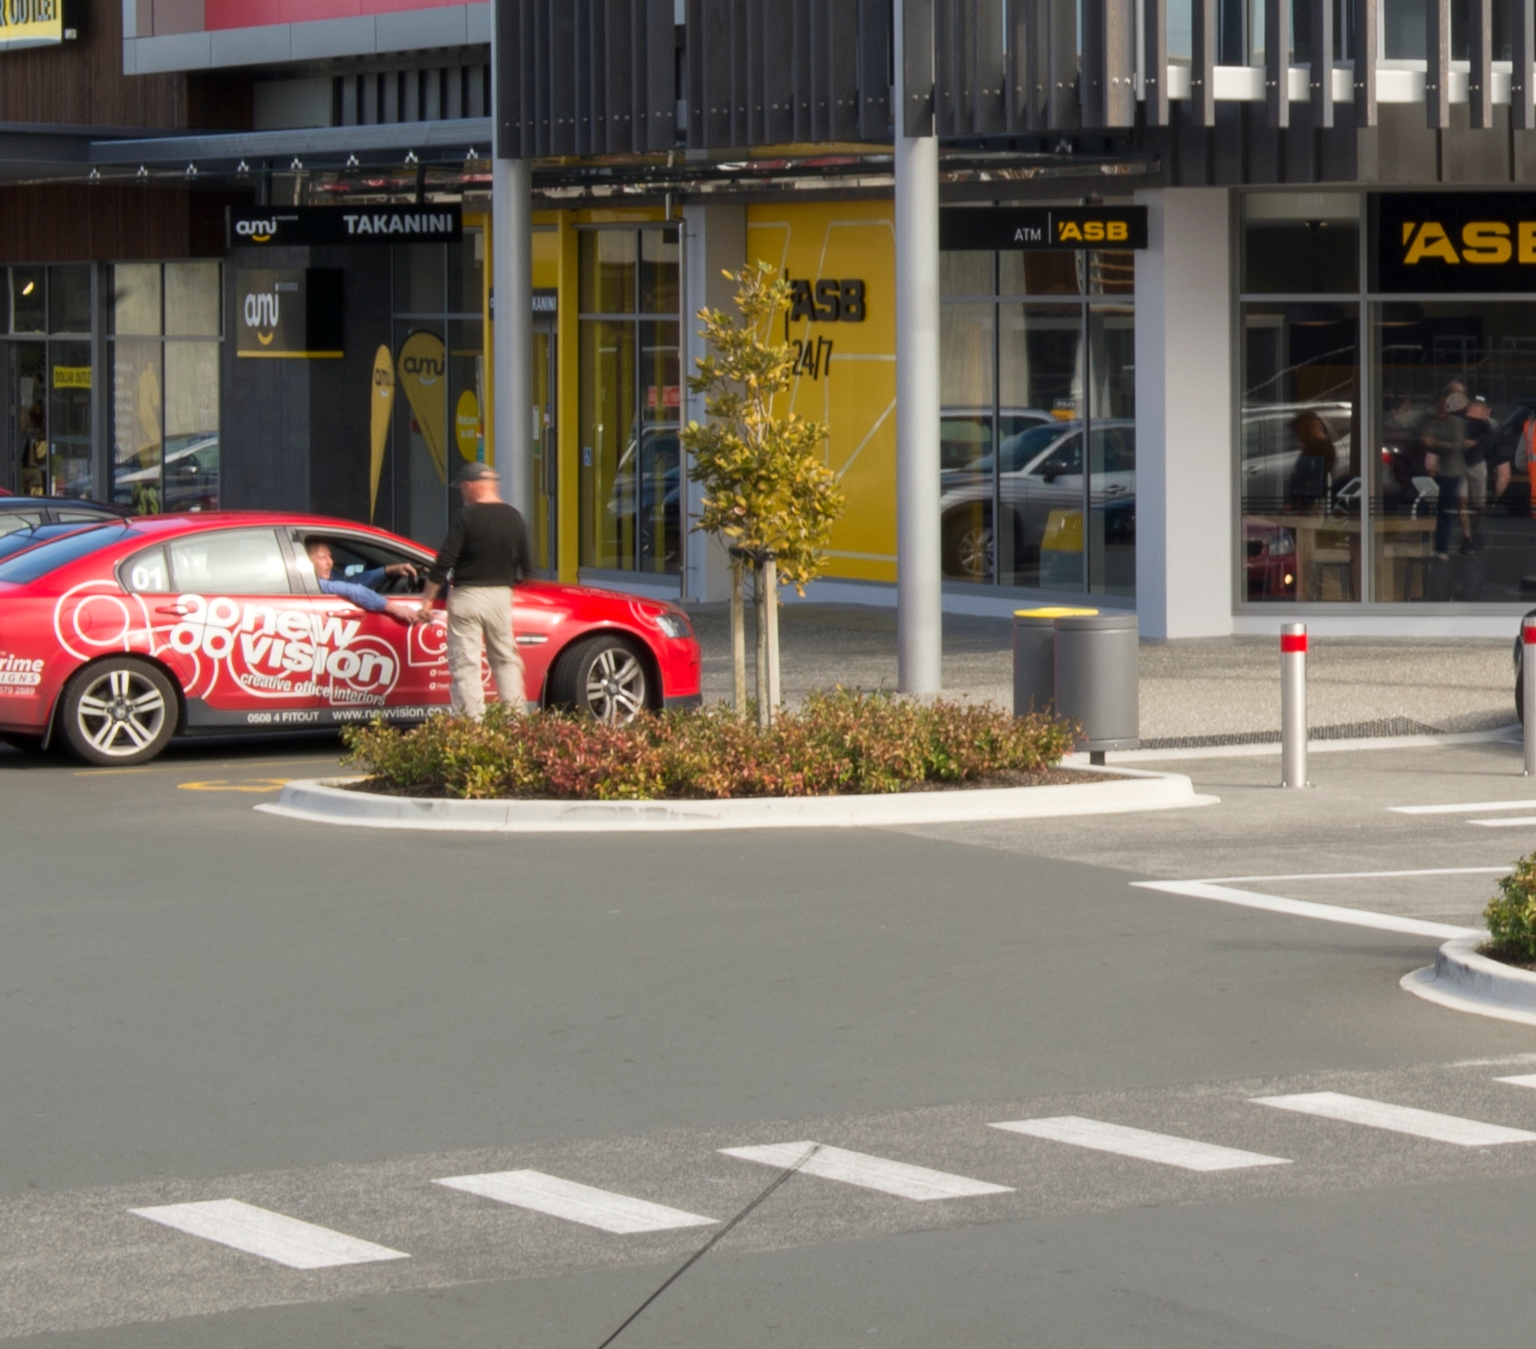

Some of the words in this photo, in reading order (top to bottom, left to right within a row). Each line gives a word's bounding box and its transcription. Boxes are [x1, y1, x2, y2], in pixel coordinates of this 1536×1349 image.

[235, 216, 278, 235] ami
[343, 213, 453, 234] TAKANINI
[1014, 227, 1042, 242] ATM
[1058, 220, 1130, 241] ASB
[788, 278, 867, 323] ASB
[791, 335, 833, 381] 24/7
[131, 566, 163, 591] 01
[240, 603, 361, 648] new
[240, 633, 395, 686] vision
[240, 672, 291, 693] creative
[294, 680, 331, 698] office
[334, 687, 387, 706] interiors
[247, 712, 272, 723] 0508
[273, 712, 280, 722] 4
[282, 711, 320, 722] FITOUT
